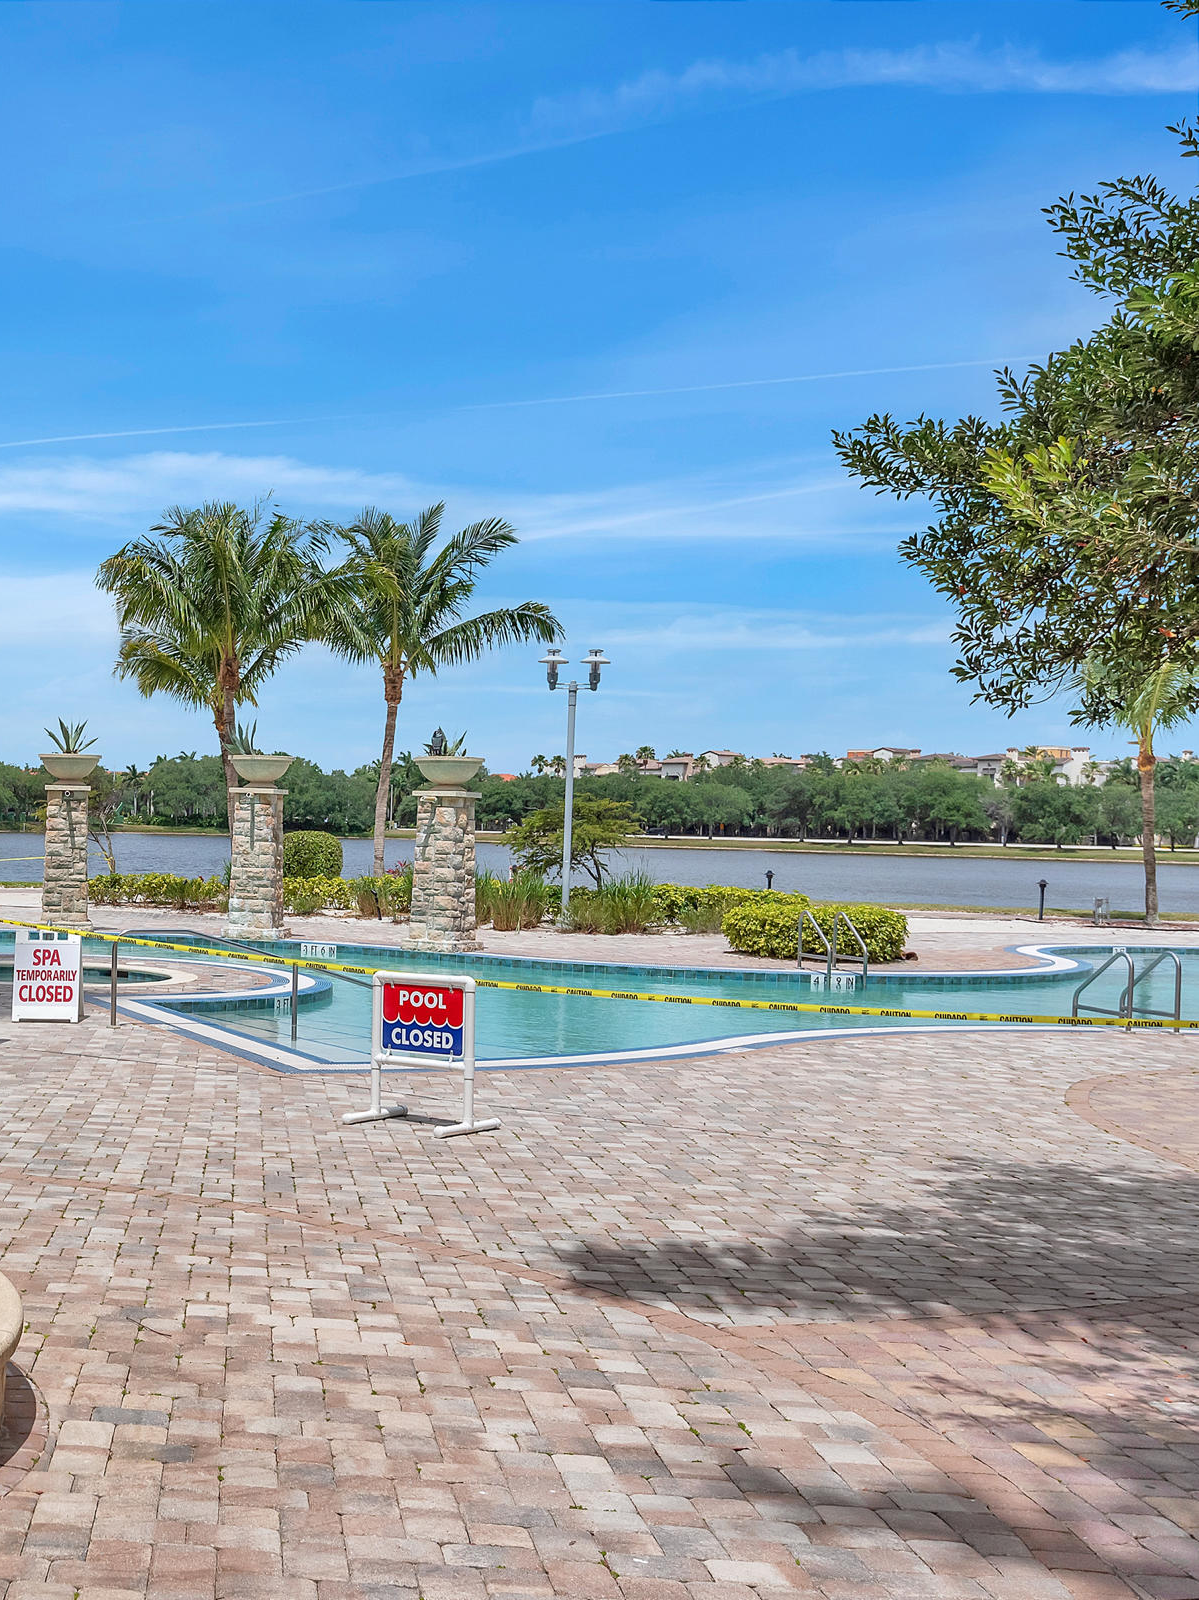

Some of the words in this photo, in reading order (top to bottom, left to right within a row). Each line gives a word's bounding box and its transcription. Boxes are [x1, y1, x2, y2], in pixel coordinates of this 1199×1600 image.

[33, 949, 61, 966] SPA
[311, 945, 318, 955] FT
[16, 970, 77, 982] TEMPORARILY
[19, 985, 73, 1002] CLOSED
[399, 990, 447, 1009] POOL
[391, 1027, 454, 1050] CLOSED
